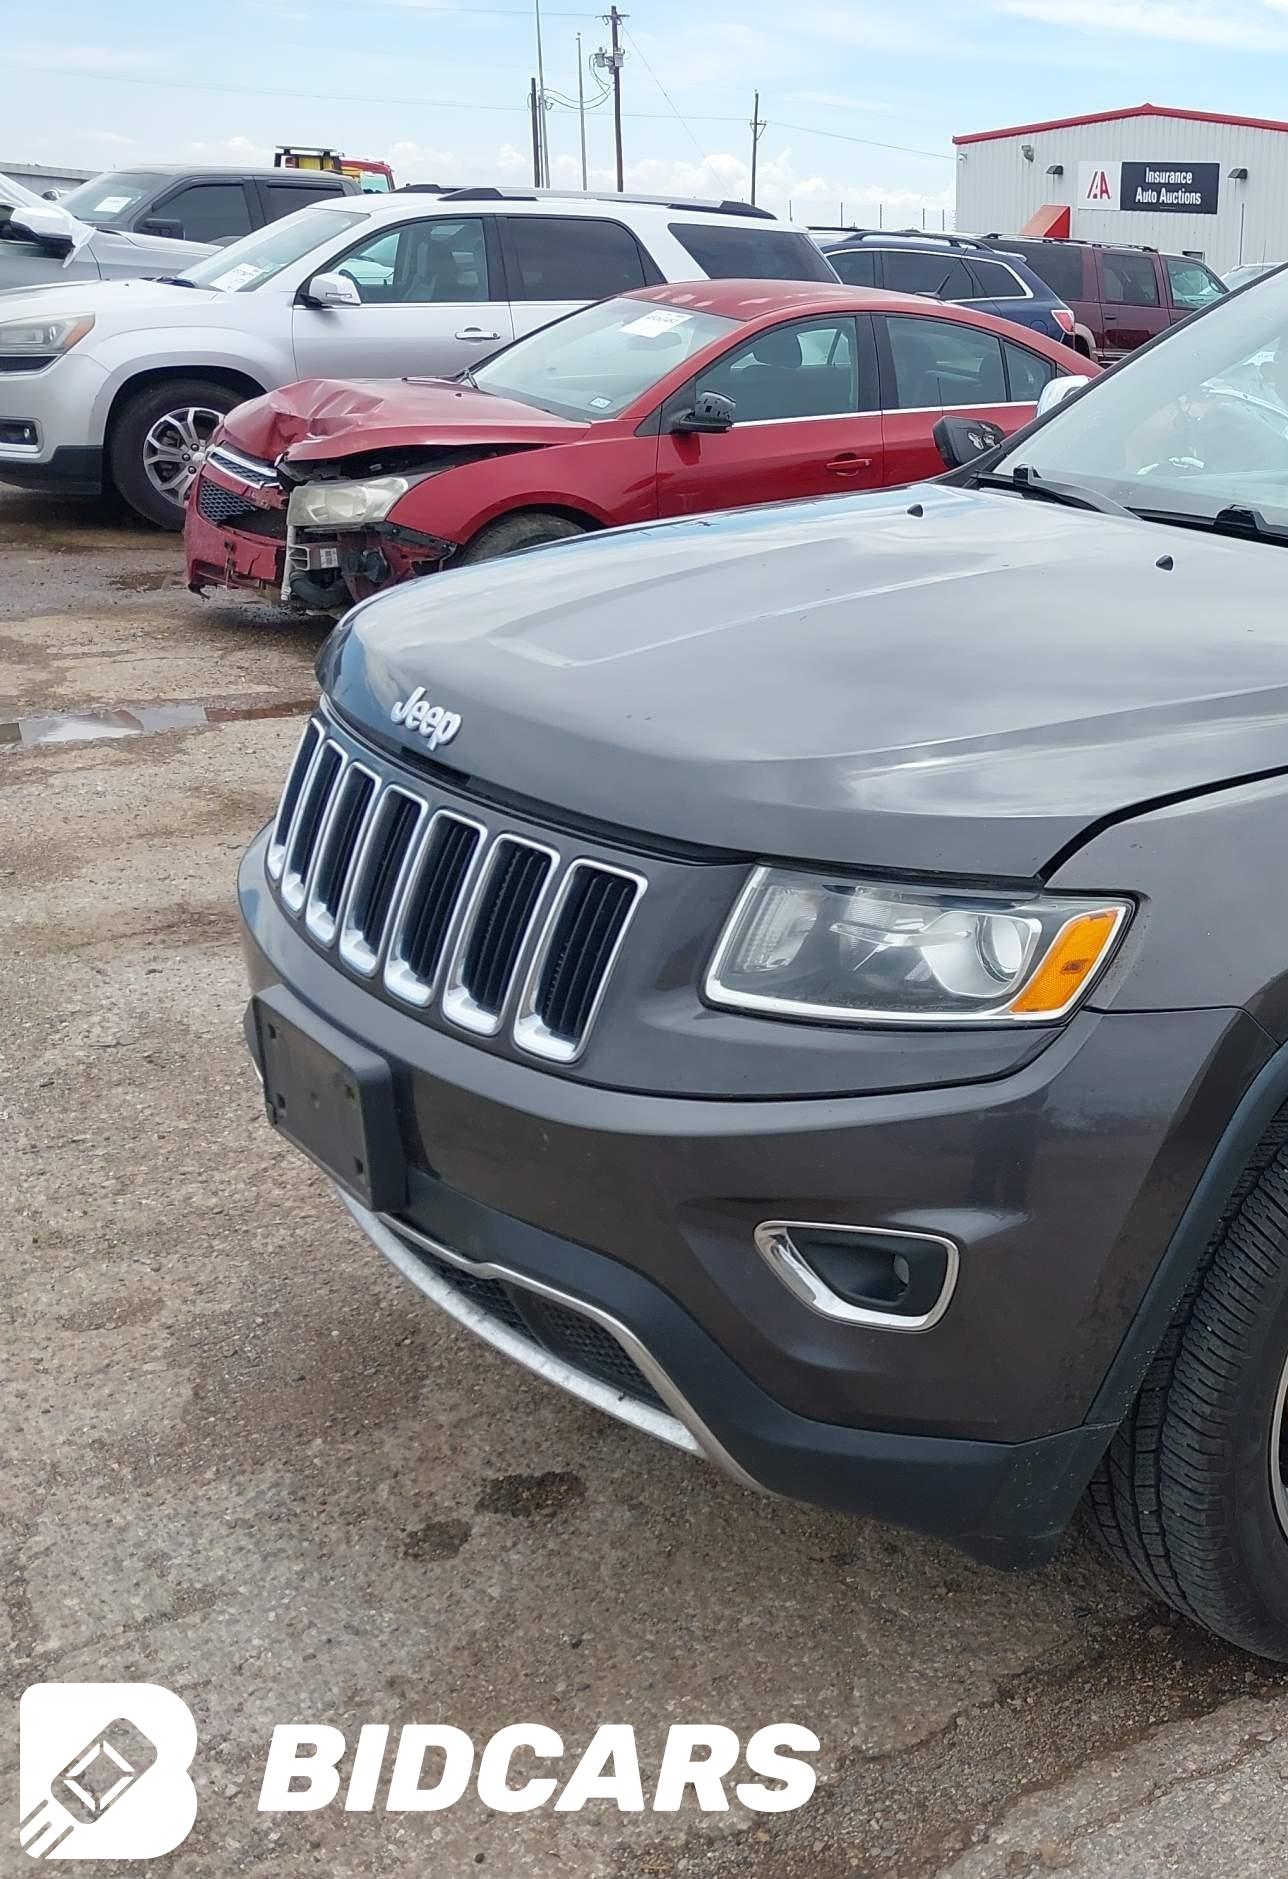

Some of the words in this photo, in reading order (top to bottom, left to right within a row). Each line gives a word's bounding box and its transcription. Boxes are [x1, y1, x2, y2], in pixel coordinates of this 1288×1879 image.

[1145, 167, 1192, 184] Insurance
[1135, 186, 1158, 203] Auto
[1159, 187, 1201, 204] Auctions
[390, 686, 461, 751] Jeep
